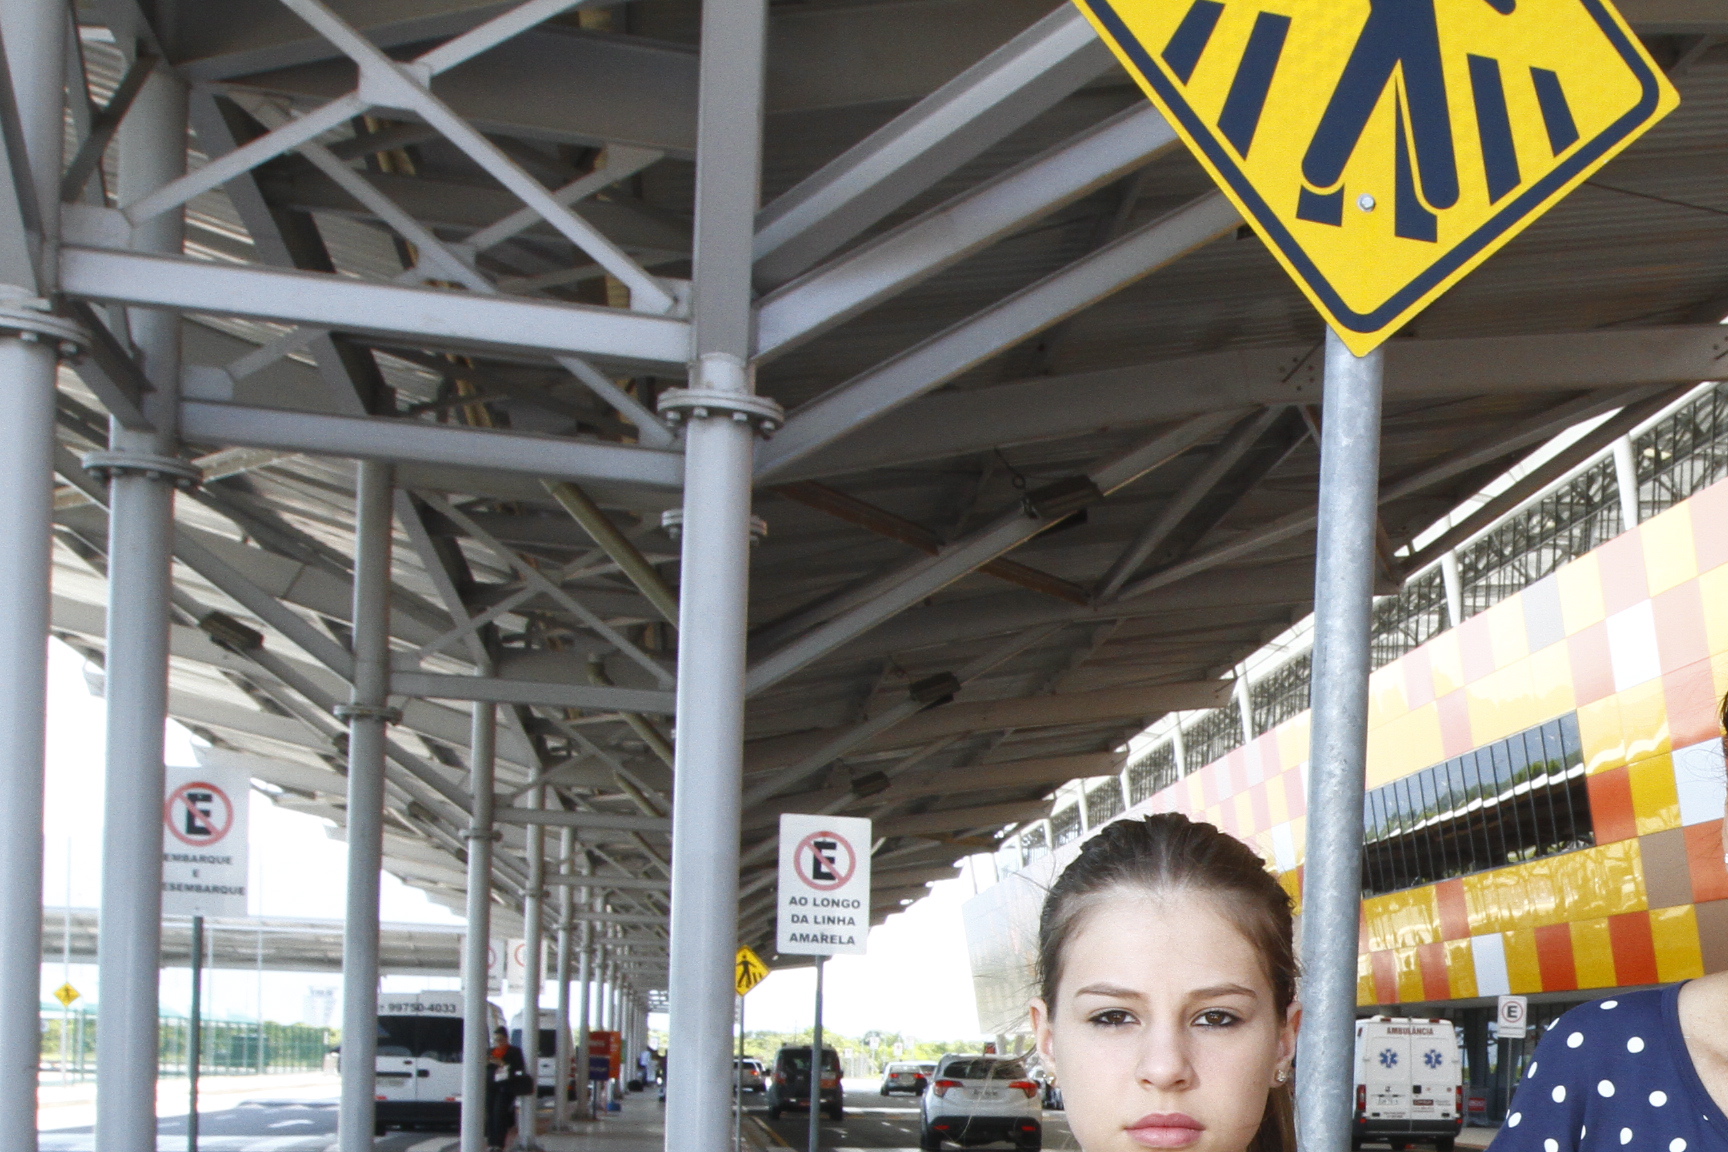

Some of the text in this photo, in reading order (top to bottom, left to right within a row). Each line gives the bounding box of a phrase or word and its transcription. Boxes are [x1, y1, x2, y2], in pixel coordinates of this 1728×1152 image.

[162, 882, 246, 896] ESEMBARQUE
[789, 896, 860, 909] AO LONGO
[791, 914, 856, 926] DA LINHA
[790, 932, 856, 945] AMARELA
[1507, 1005, 1518, 1018] E
[1387, 1026, 1434, 1035] AMBULÂNCIA
